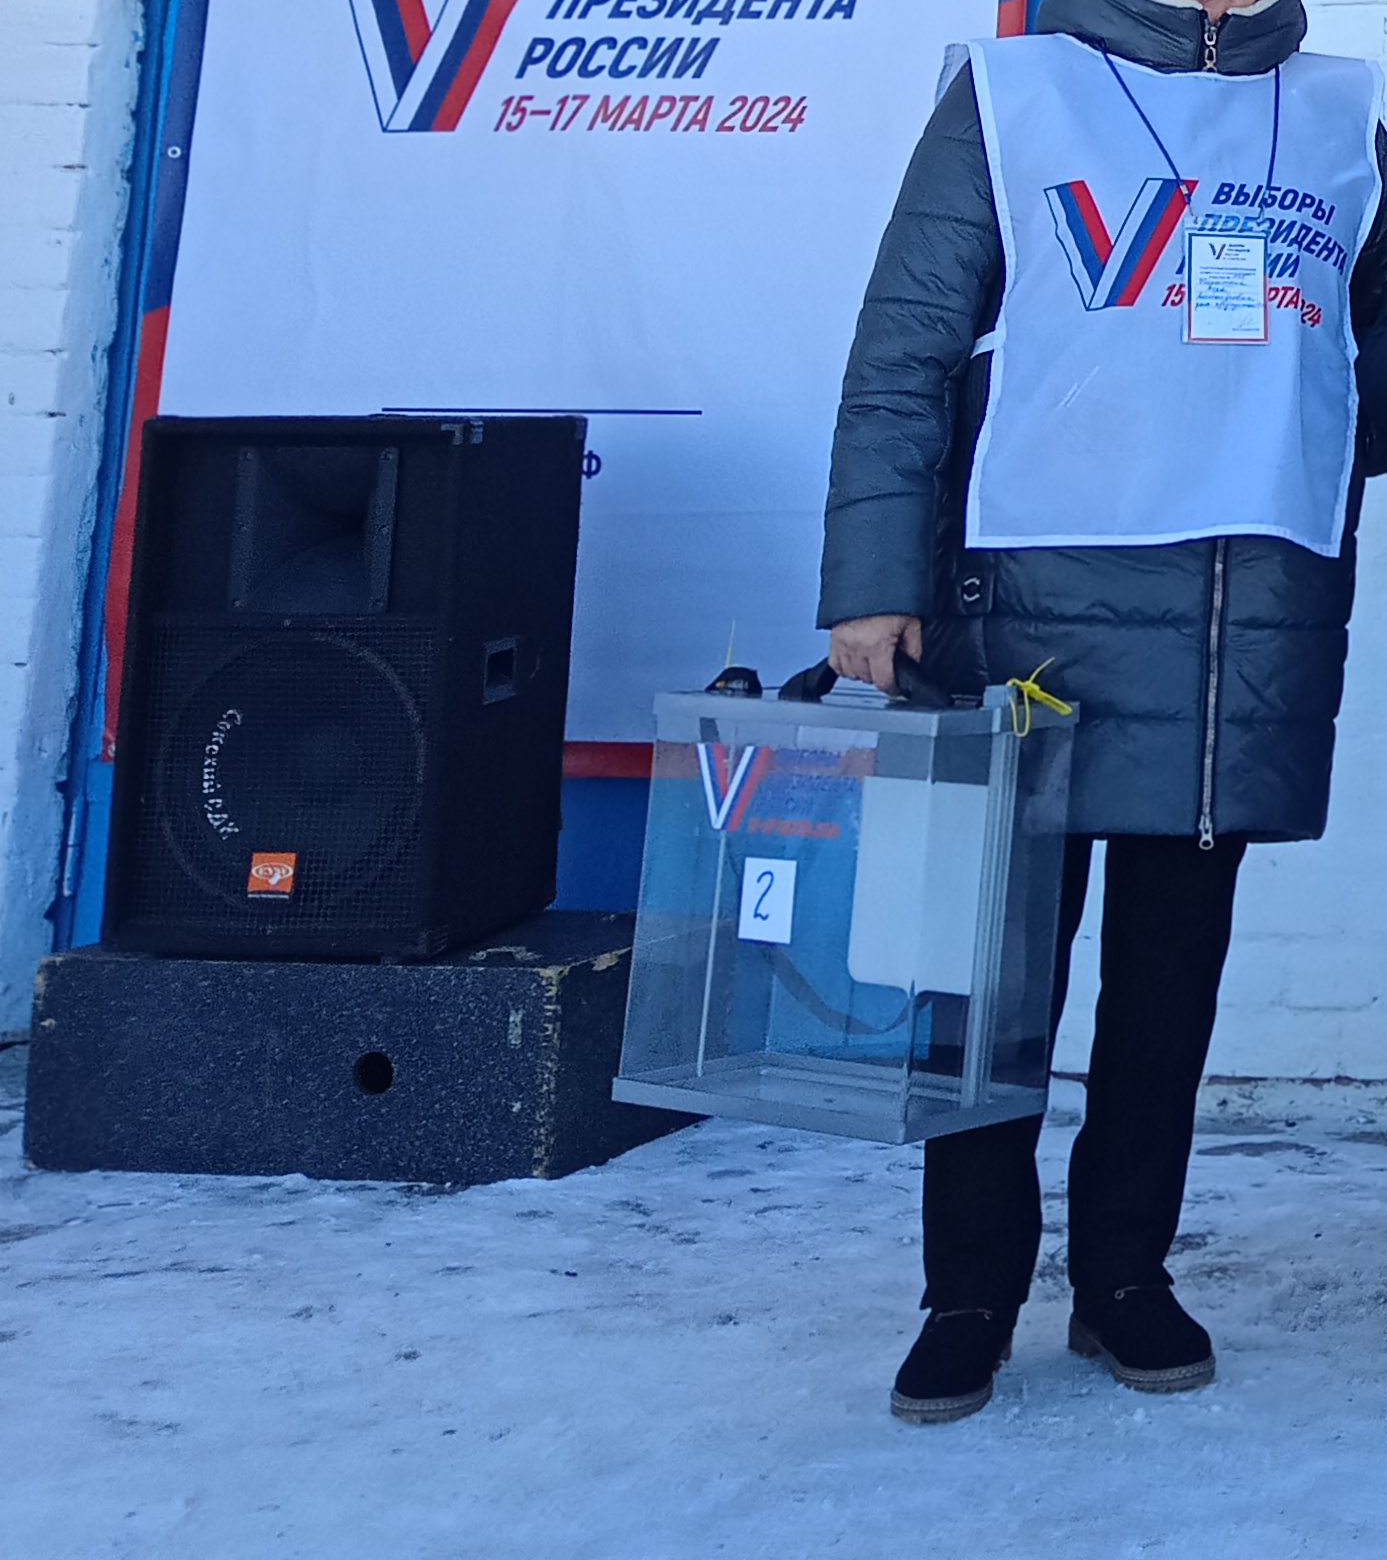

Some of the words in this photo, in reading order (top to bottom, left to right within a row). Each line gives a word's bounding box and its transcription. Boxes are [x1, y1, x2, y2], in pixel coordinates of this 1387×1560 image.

[515, 36, 721, 80] РОССИИ
[586, 94, 715, 133] МАРТА
[715, 94, 808, 133] 2024
[1211, 181, 1336, 226] ВЫБОРЫ
[753, 870, 775, 922] 2
